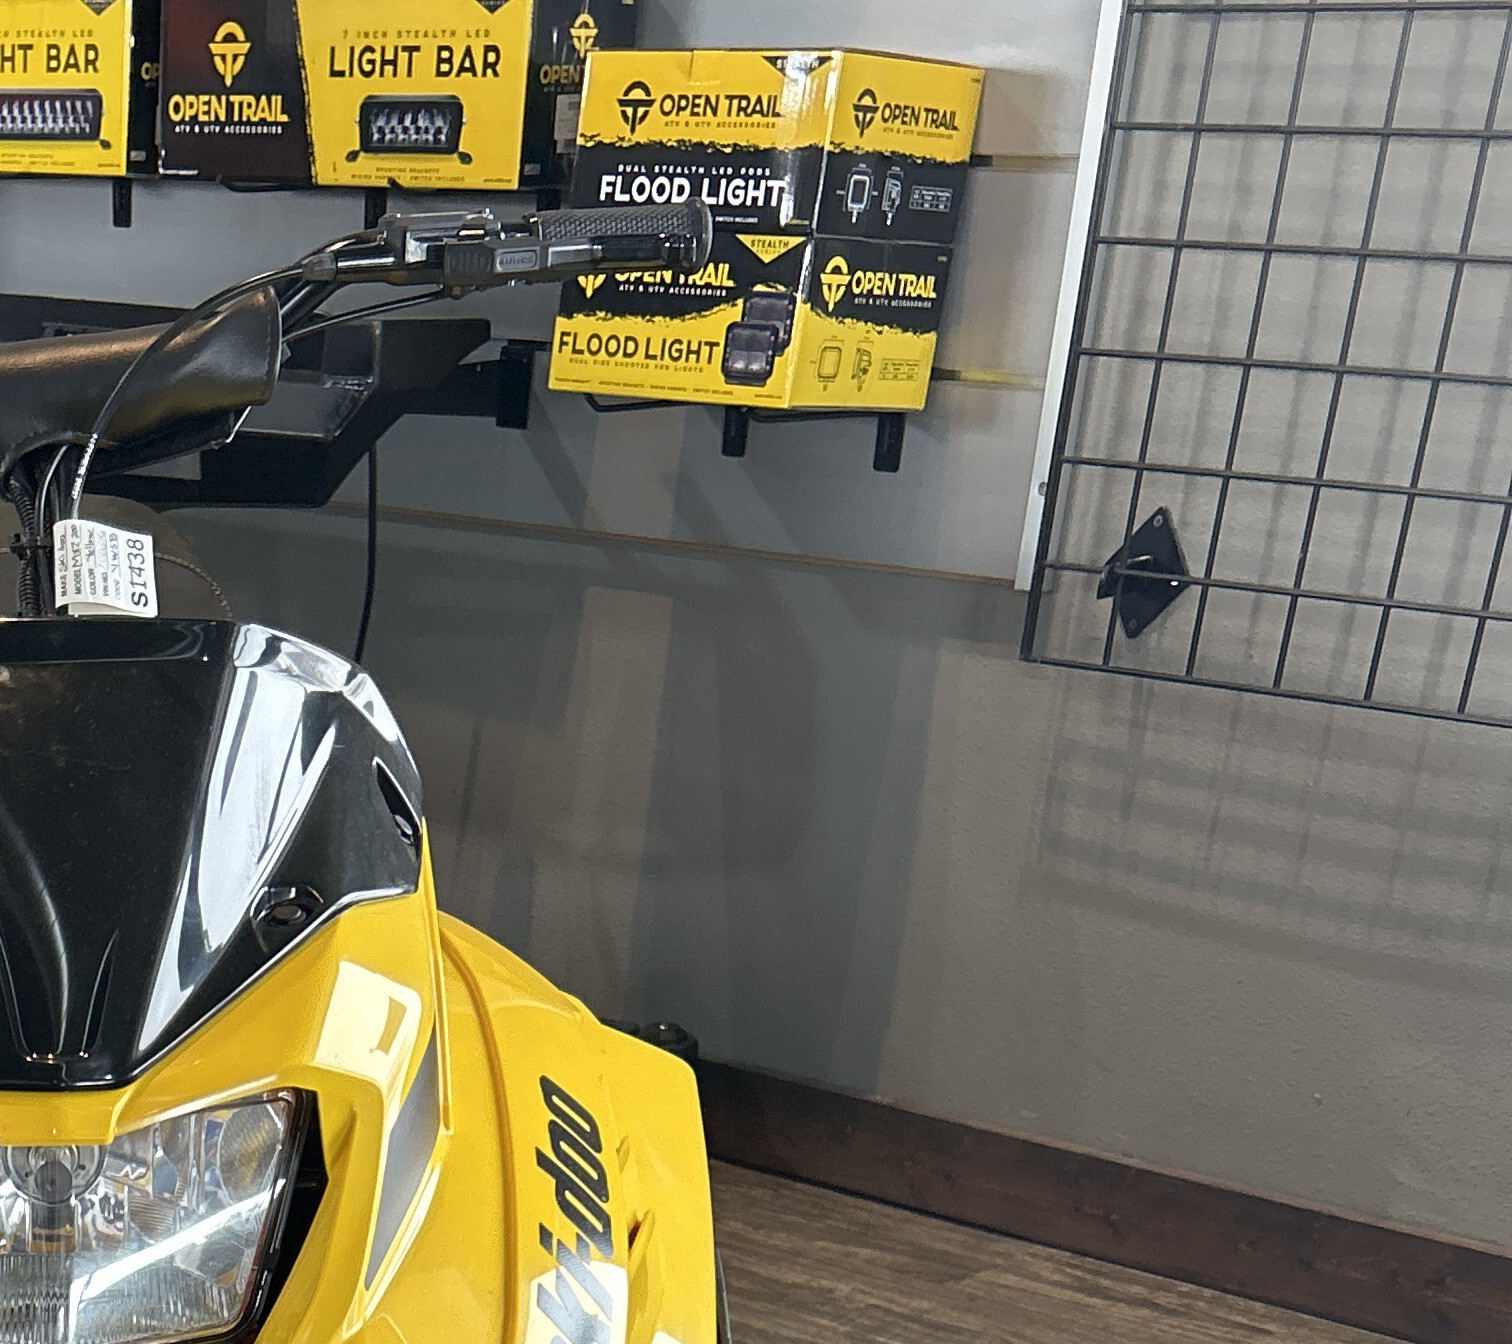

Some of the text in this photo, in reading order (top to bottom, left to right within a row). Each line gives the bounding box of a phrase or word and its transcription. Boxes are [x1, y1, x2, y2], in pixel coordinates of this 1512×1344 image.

[72, 28, 95, 38] LED
[356, 30, 389, 40] INCH
[396, 29, 457, 39] STEALTH
[465, 28, 492, 39] LED
[45, 43, 100, 74] BAR
[328, 44, 502, 78] LIGHT BAR
[168, 94, 290, 122] OPEN TRAIL
[658, 94, 784, 119] OPEN TRAIL
[880, 102, 960, 132] OPEN TRAIL
[174, 125, 190, 134] ATV
[203, 125, 220, 134] UTV
[223, 124, 283, 135] ACCESSORIES
[716, 120, 776, 130] ACCESSORIES
[617, 163, 647, 174] DUAL
[653, 164, 706, 175] STEALTH
[710, 165, 734, 176] LED
[599, 174, 789, 208] FLOOD LIGHT
[750, 238, 790, 249] STEALTH
[618, 284, 635, 292] ATV
[648, 285, 665, 294] UTV
[668, 286, 727, 297] ACCESSORIES
[851, 269, 937, 299] OPEN TRAIL
[557, 330, 721, 366] FLOOD LIGHT
[73, 568, 82, 595] MODEL
[88, 568, 97, 596] COLOR
